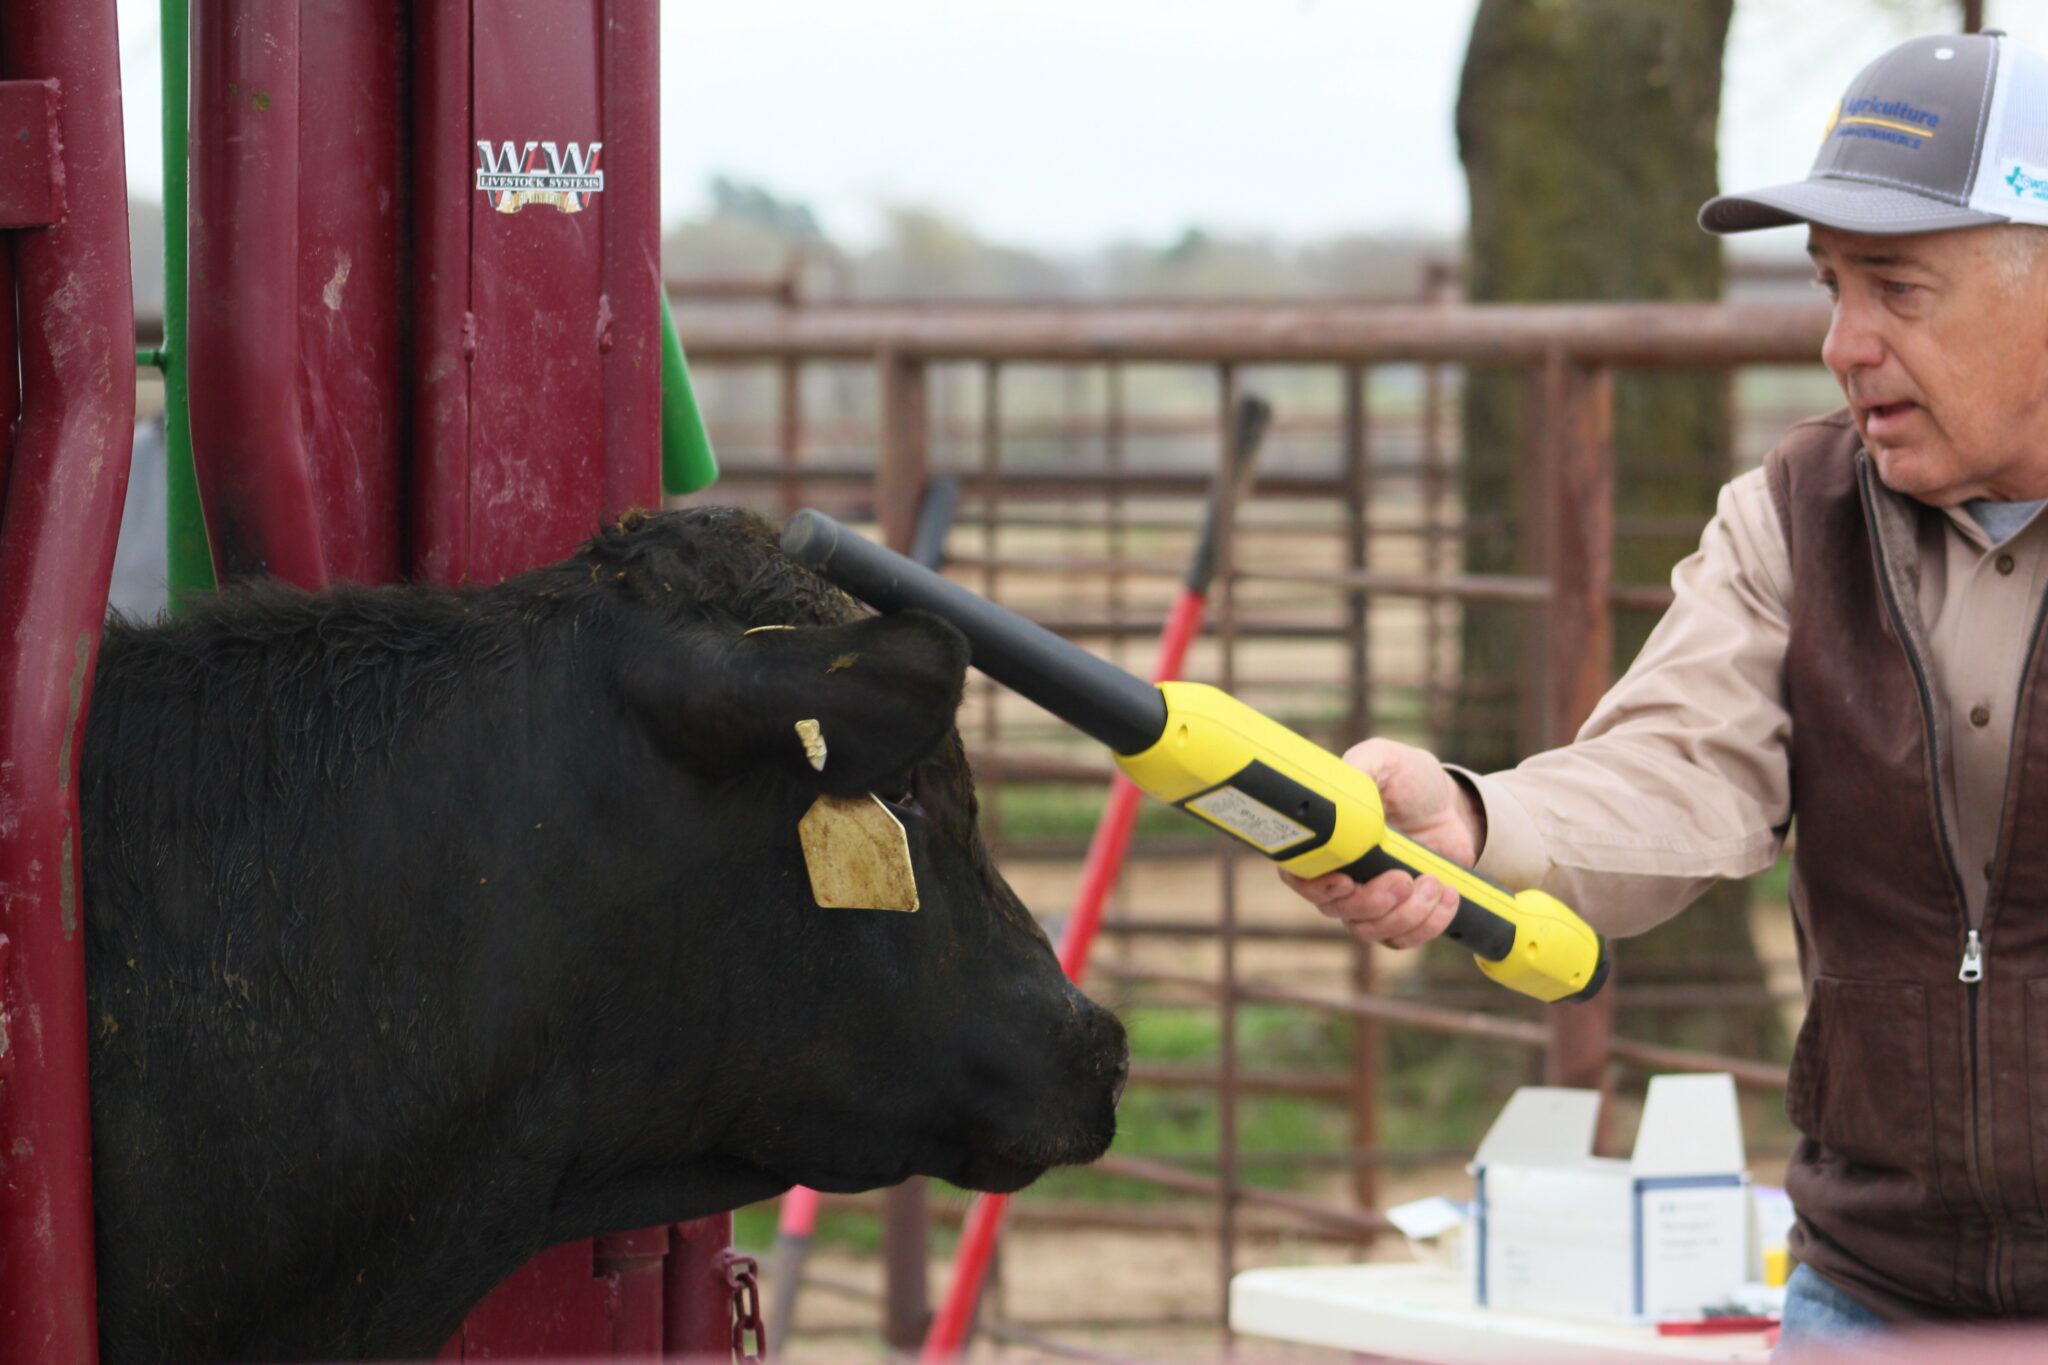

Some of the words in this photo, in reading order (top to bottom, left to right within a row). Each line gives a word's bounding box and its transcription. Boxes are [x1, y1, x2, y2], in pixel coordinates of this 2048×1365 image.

[1845, 97, 1940, 127] griculture
[481, 176, 545, 188] LIVESTOCK
[549, 177, 600, 188] SYSTEMS
